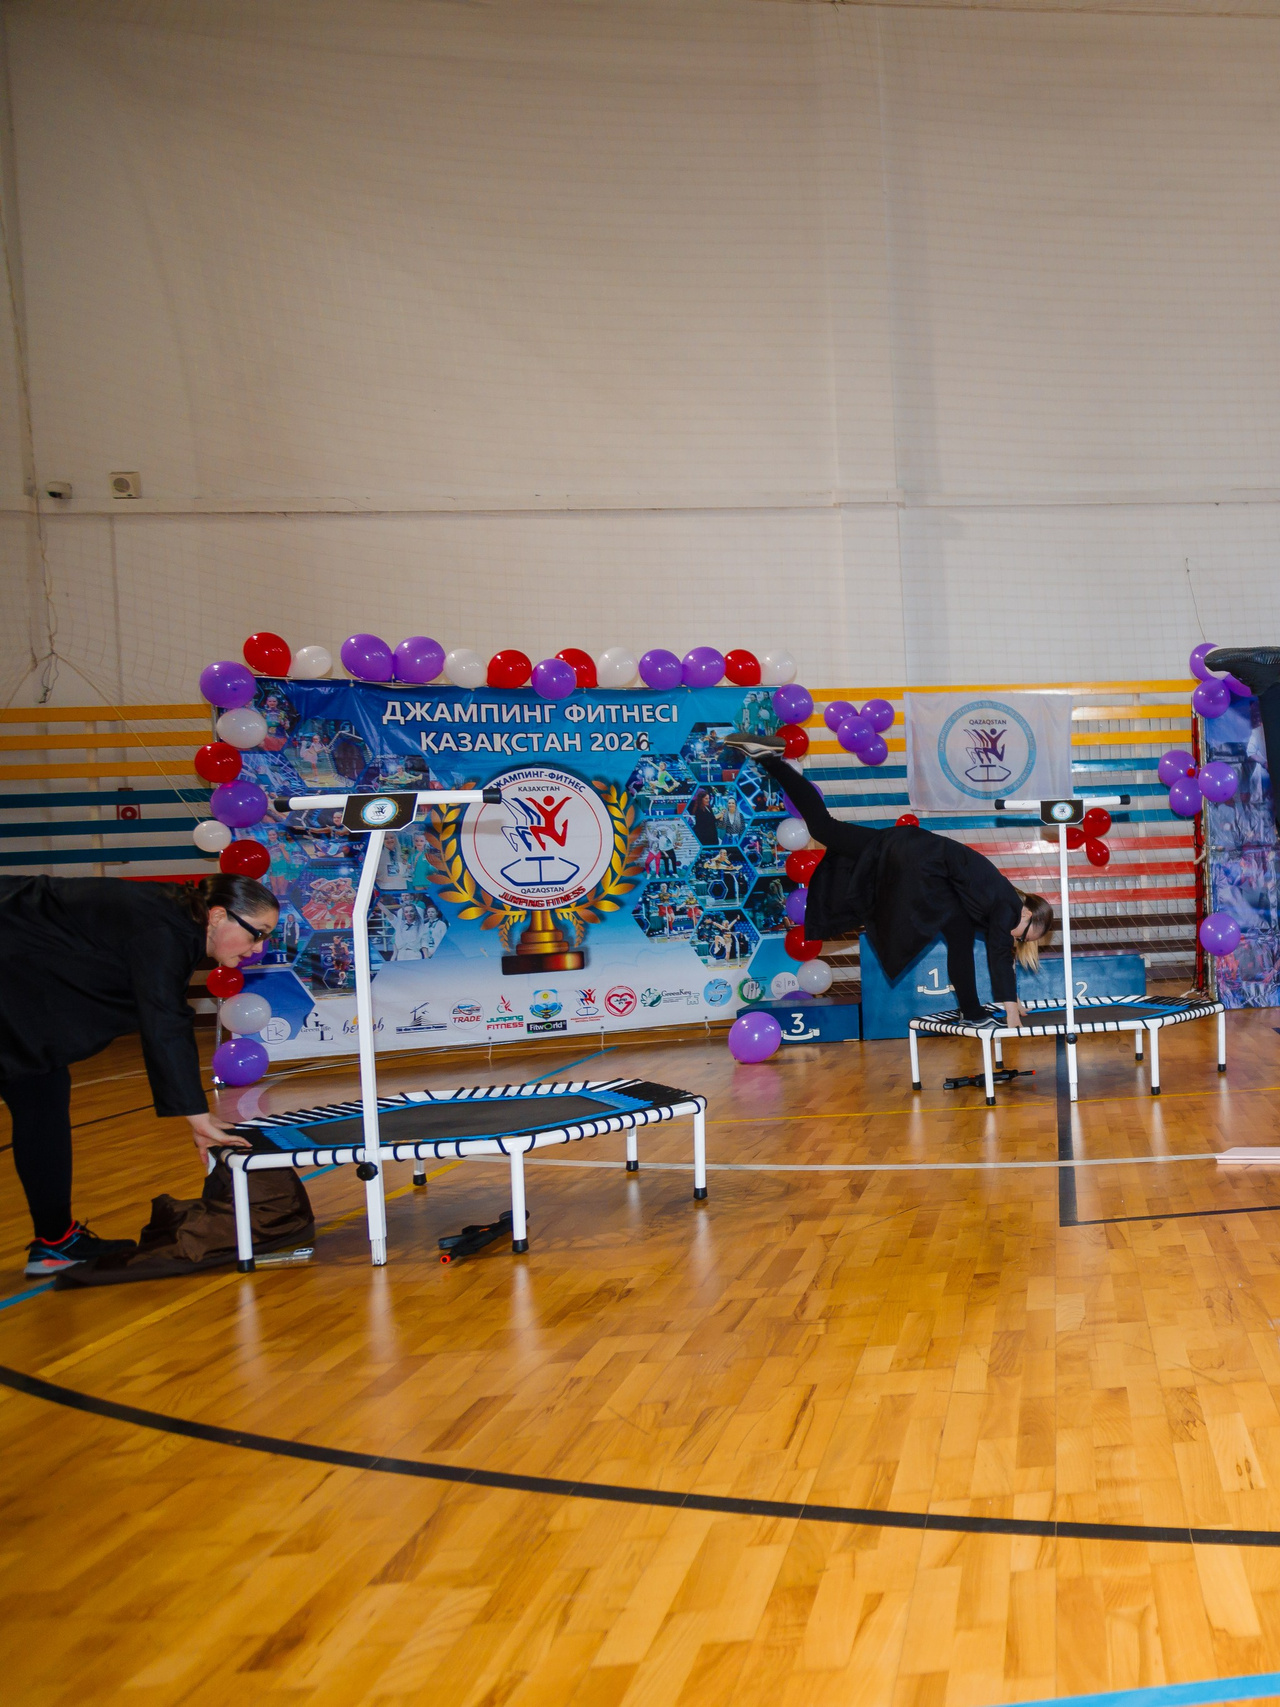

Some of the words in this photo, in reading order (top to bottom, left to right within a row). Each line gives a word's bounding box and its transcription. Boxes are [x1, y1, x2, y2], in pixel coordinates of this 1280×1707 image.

[382, 701, 557, 725] ДЖАМПИНГ
[563, 704, 678, 723] ФИТНЕСІ
[420, 731, 582, 756] ҚАЗАҚСТАН
[589, 732, 651, 752] 2026
[499, 892, 545, 908] JUMPING
[546, 885, 586, 907] FITNESS
[928, 968, 938, 988] 1
[1075, 981, 1088, 999] 2
[453, 1015, 481, 1023] TRADE
[791, 1013, 805, 1033] 3
